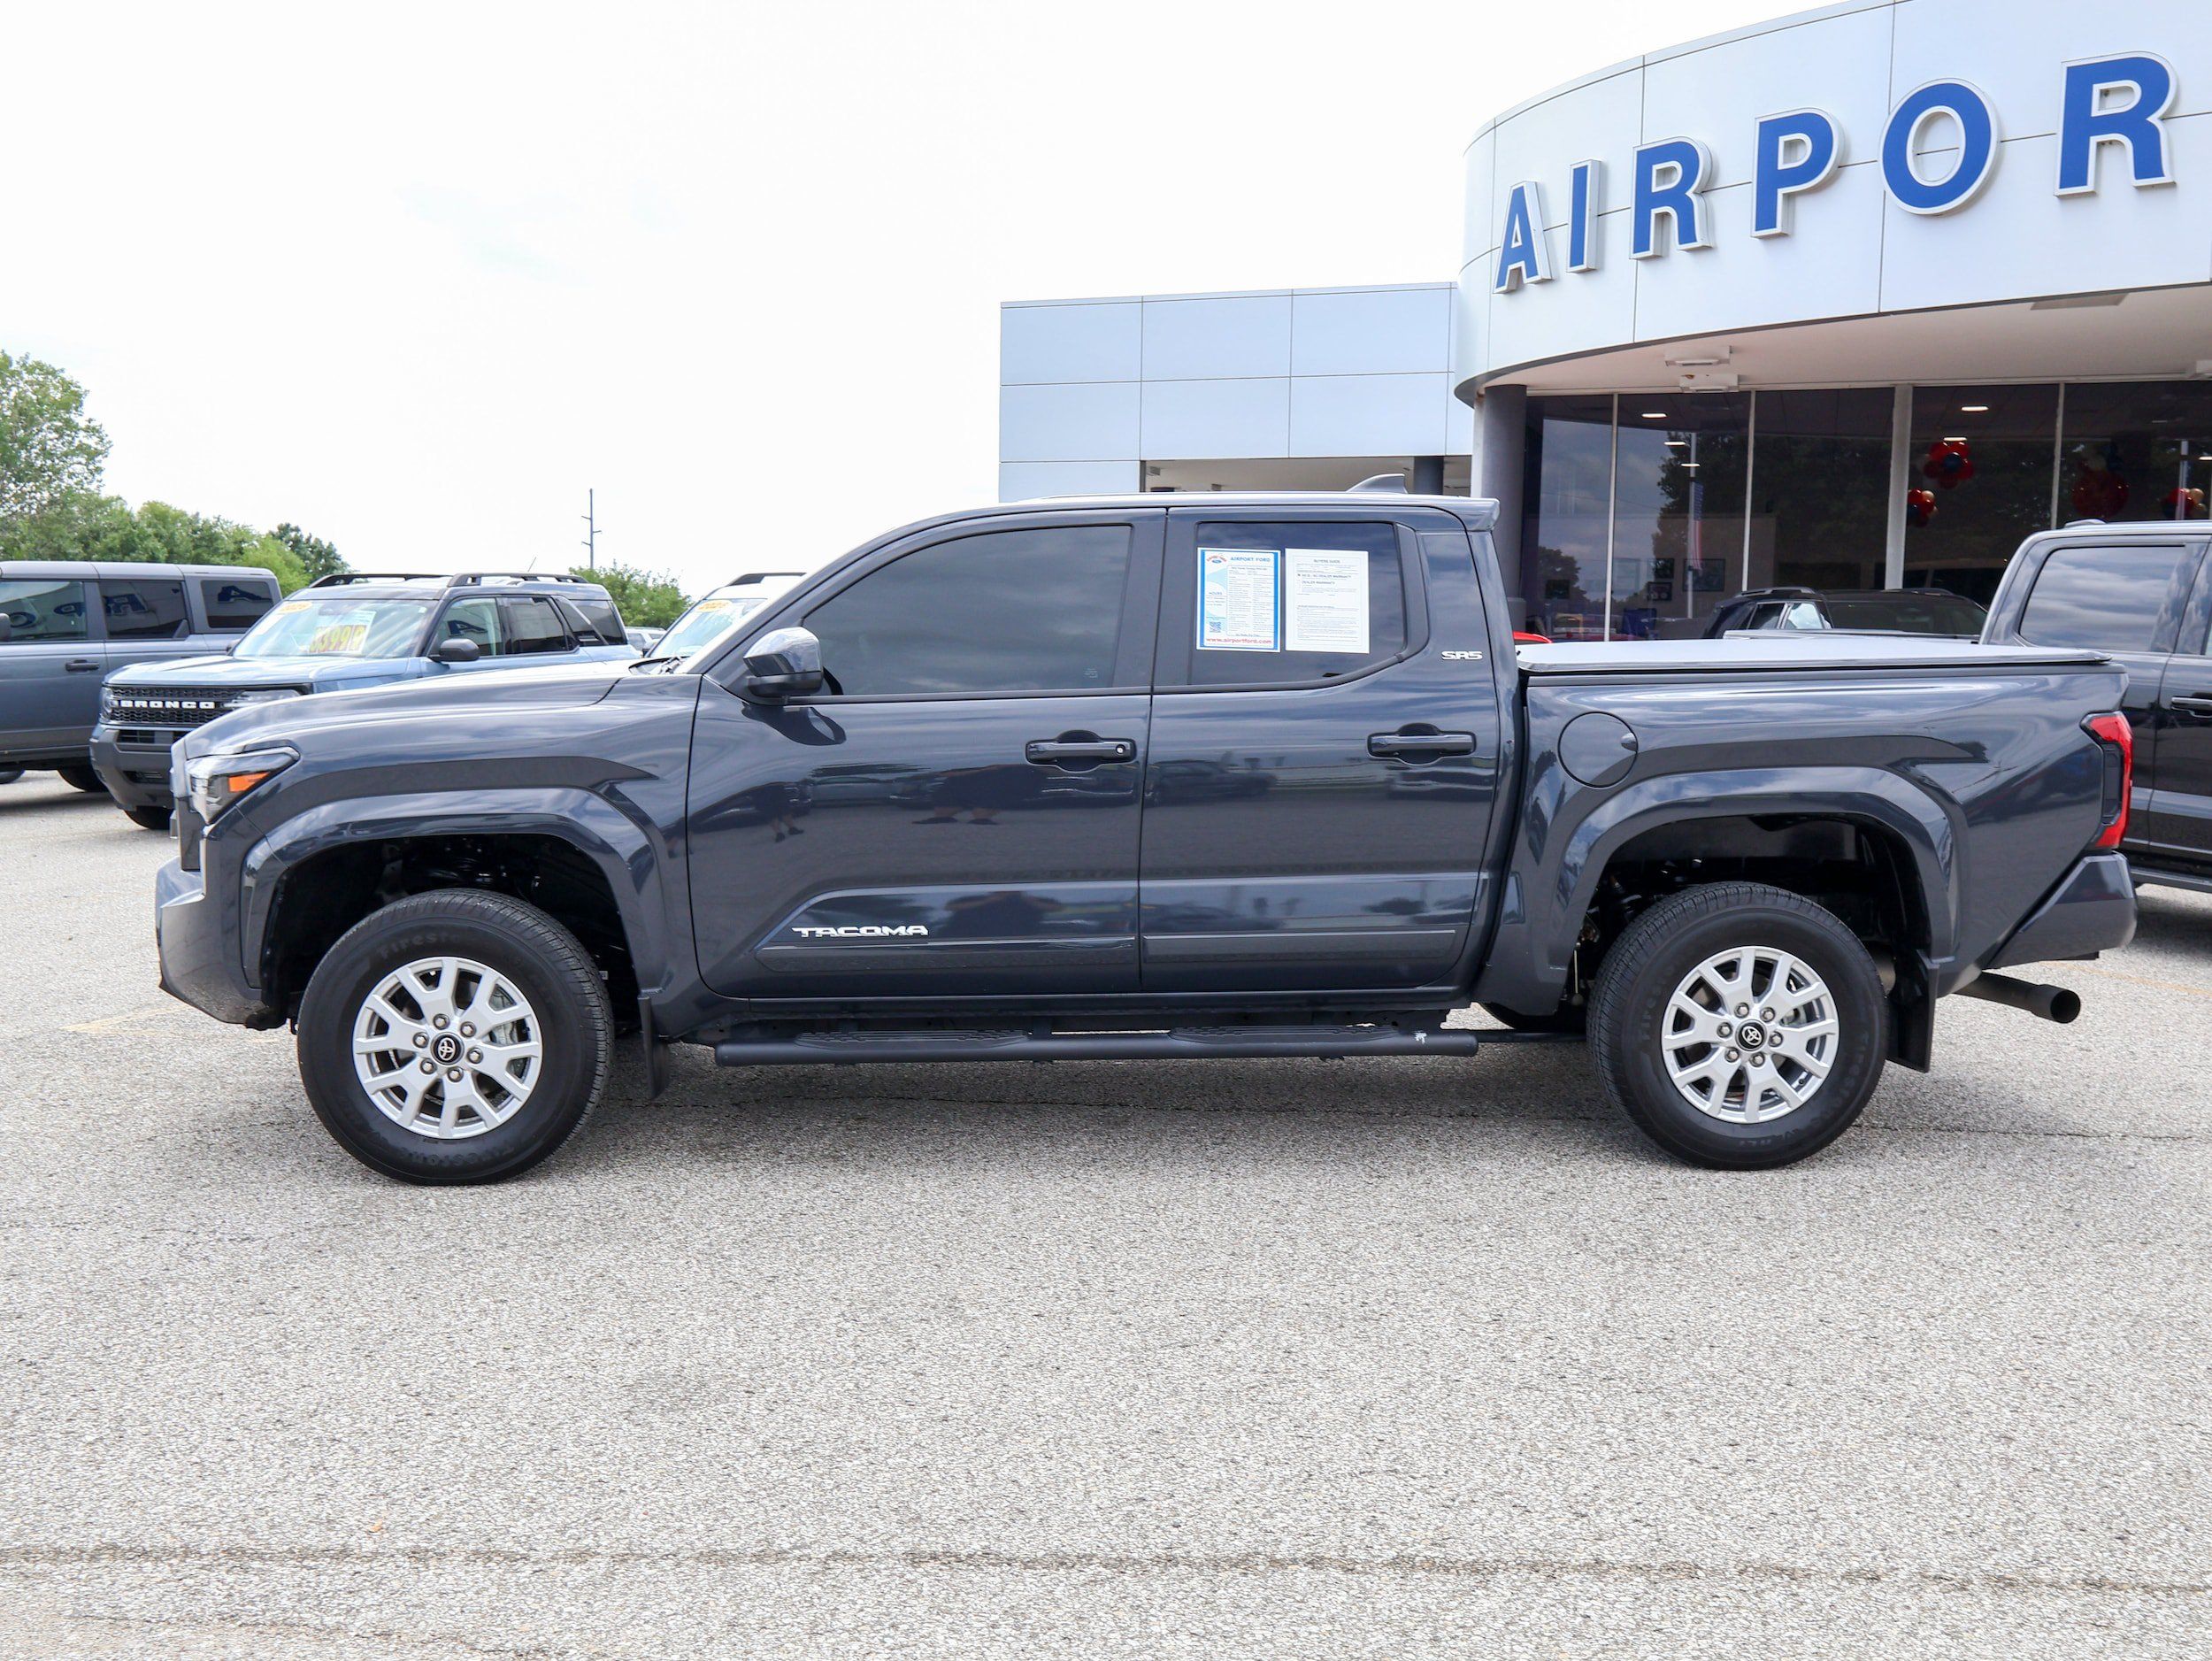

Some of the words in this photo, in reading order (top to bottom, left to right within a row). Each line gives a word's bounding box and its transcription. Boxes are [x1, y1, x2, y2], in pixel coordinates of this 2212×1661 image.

[1441, 650, 1483, 660] SR5
[119, 700, 215, 710] BRONCO
[792, 925, 929, 938] TACOMA
